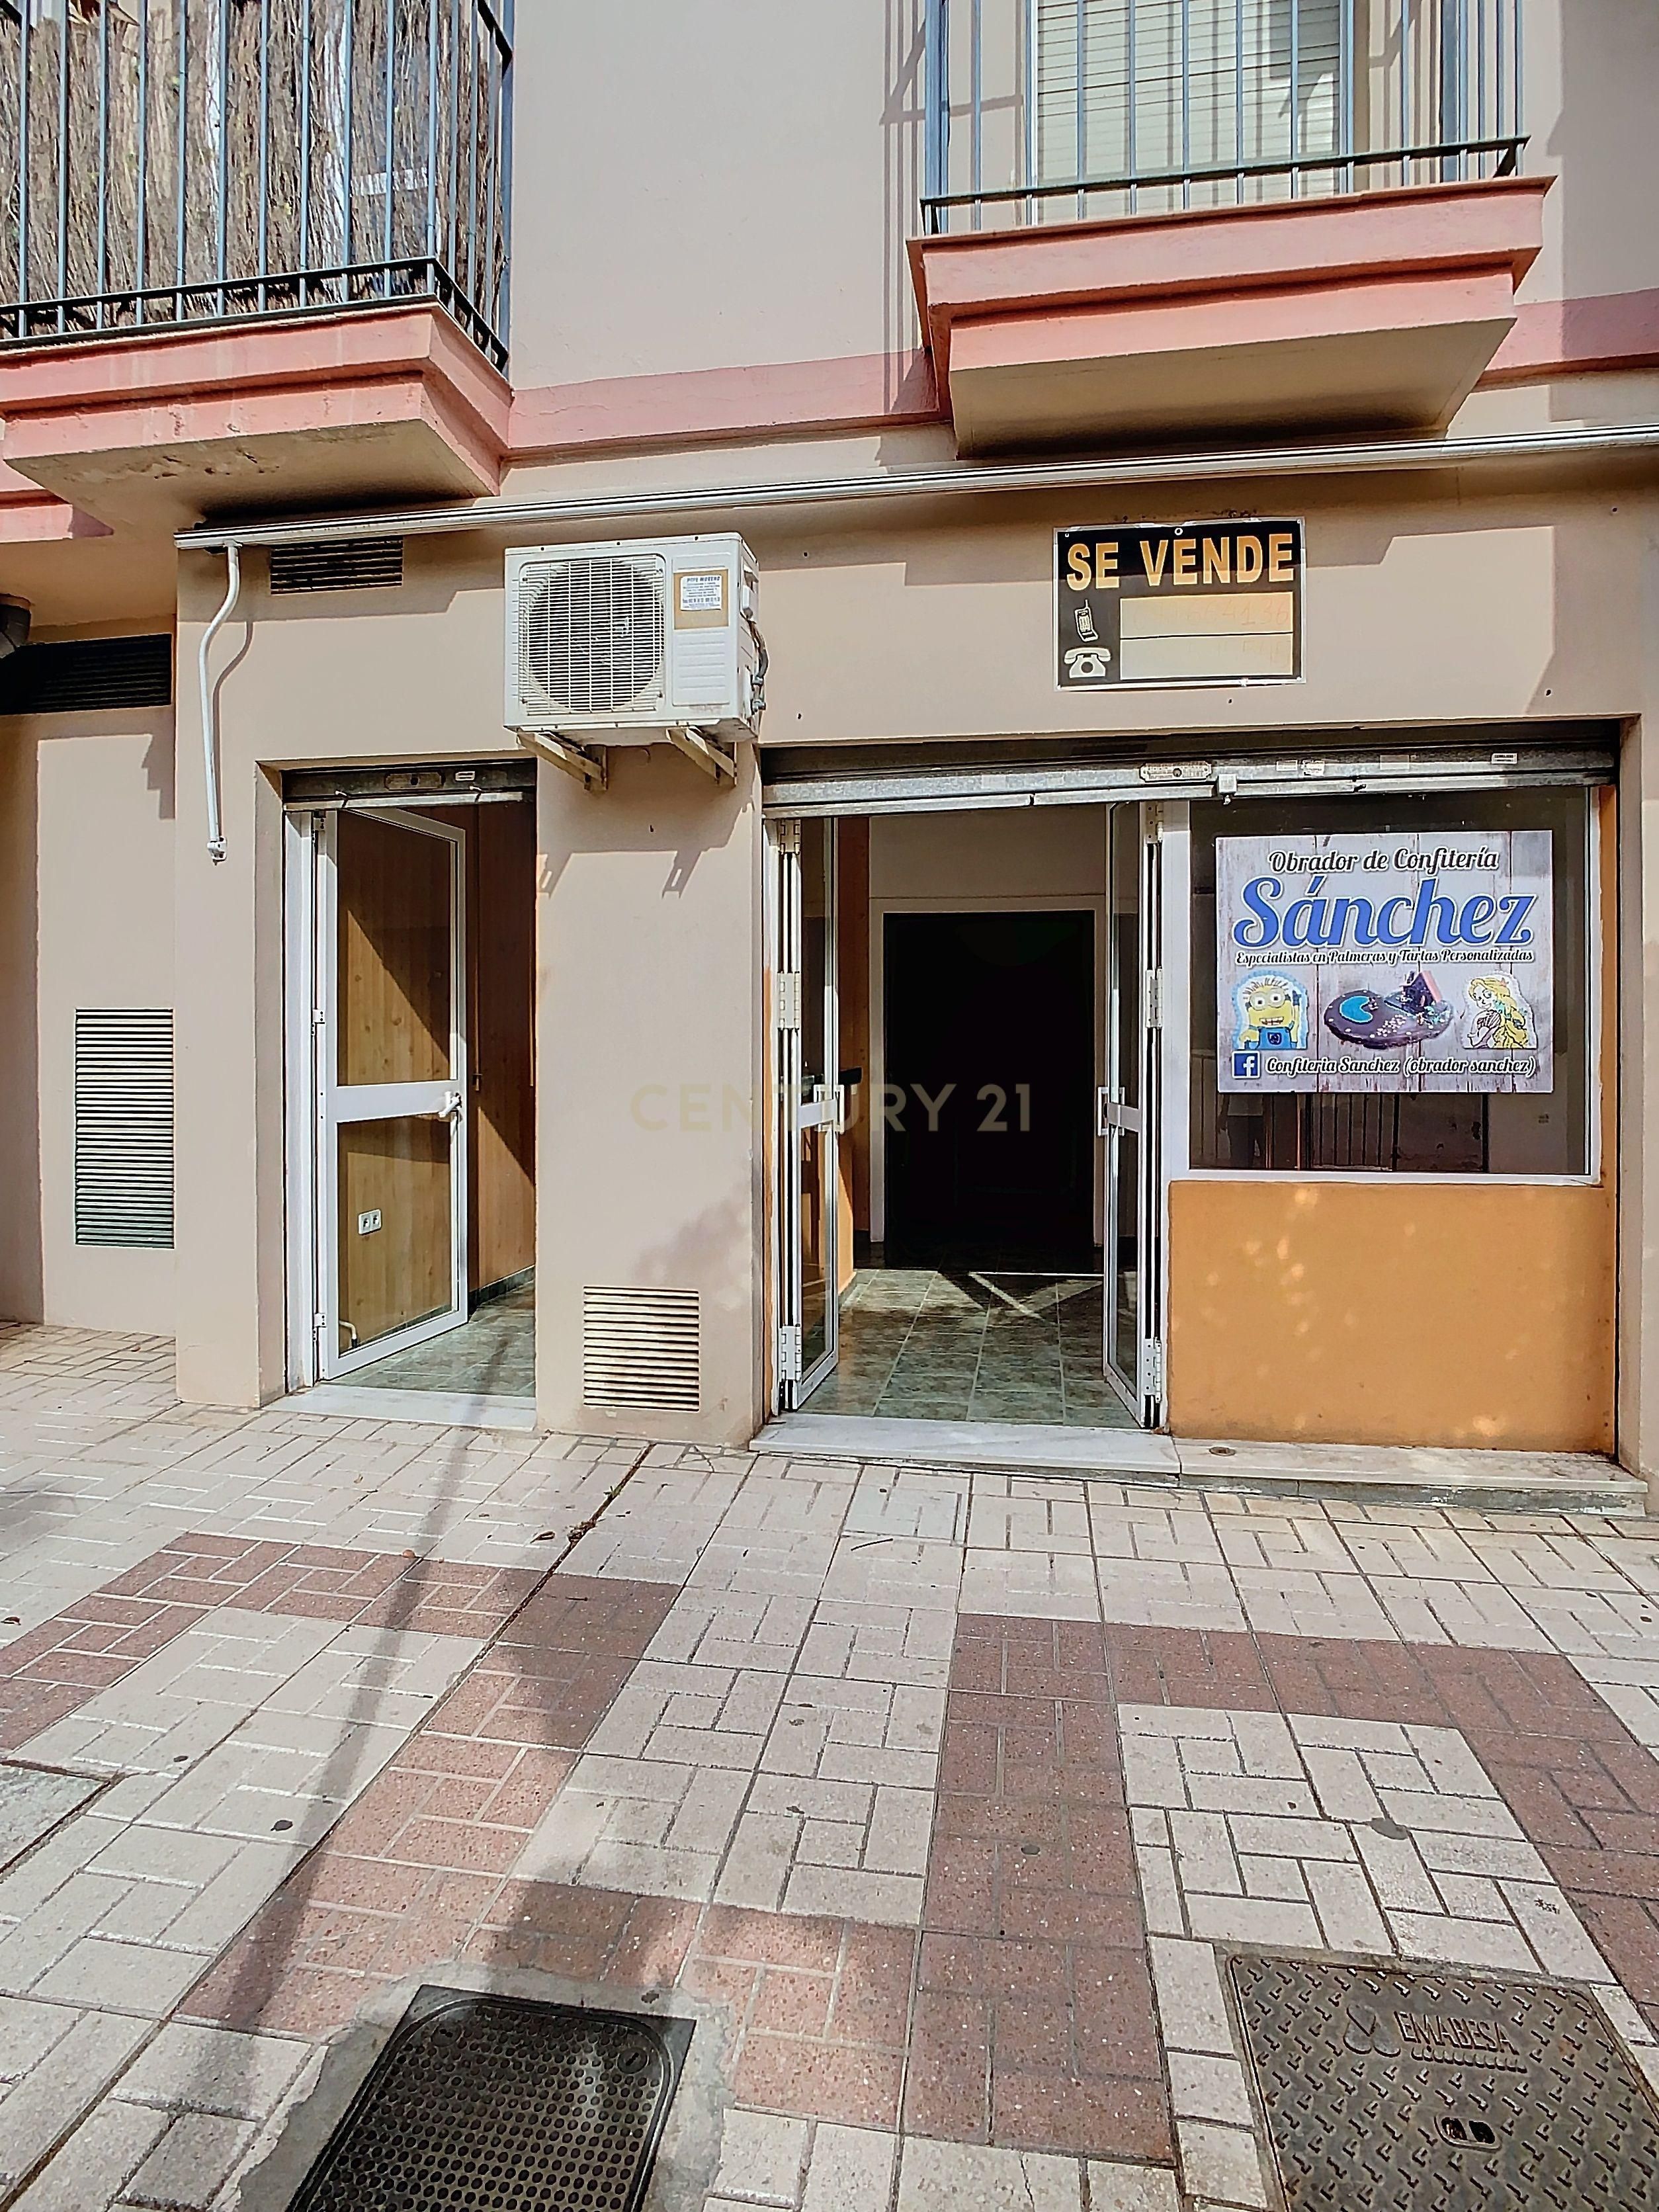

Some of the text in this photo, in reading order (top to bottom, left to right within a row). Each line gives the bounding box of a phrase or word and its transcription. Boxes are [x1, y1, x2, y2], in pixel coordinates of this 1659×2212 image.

[1066, 533, 1294, 591] SE VENDE
[1269, 847, 1498, 874] Obrador de Confitería
[1234, 875, 1535, 947] Sánchez
[1236, 949, 1533, 966] Especialistas en Palmeras y Tartas Personalizadas
[1267, 1057, 1336, 1076] Confiteria
[1339, 1057, 1399, 1072] Sanchez
[1404, 1057, 1468, 1076] (obrador
[1470, 1057, 1536, 1077] sanchez)
[1393, 2010, 1520, 2055] EMABESA
